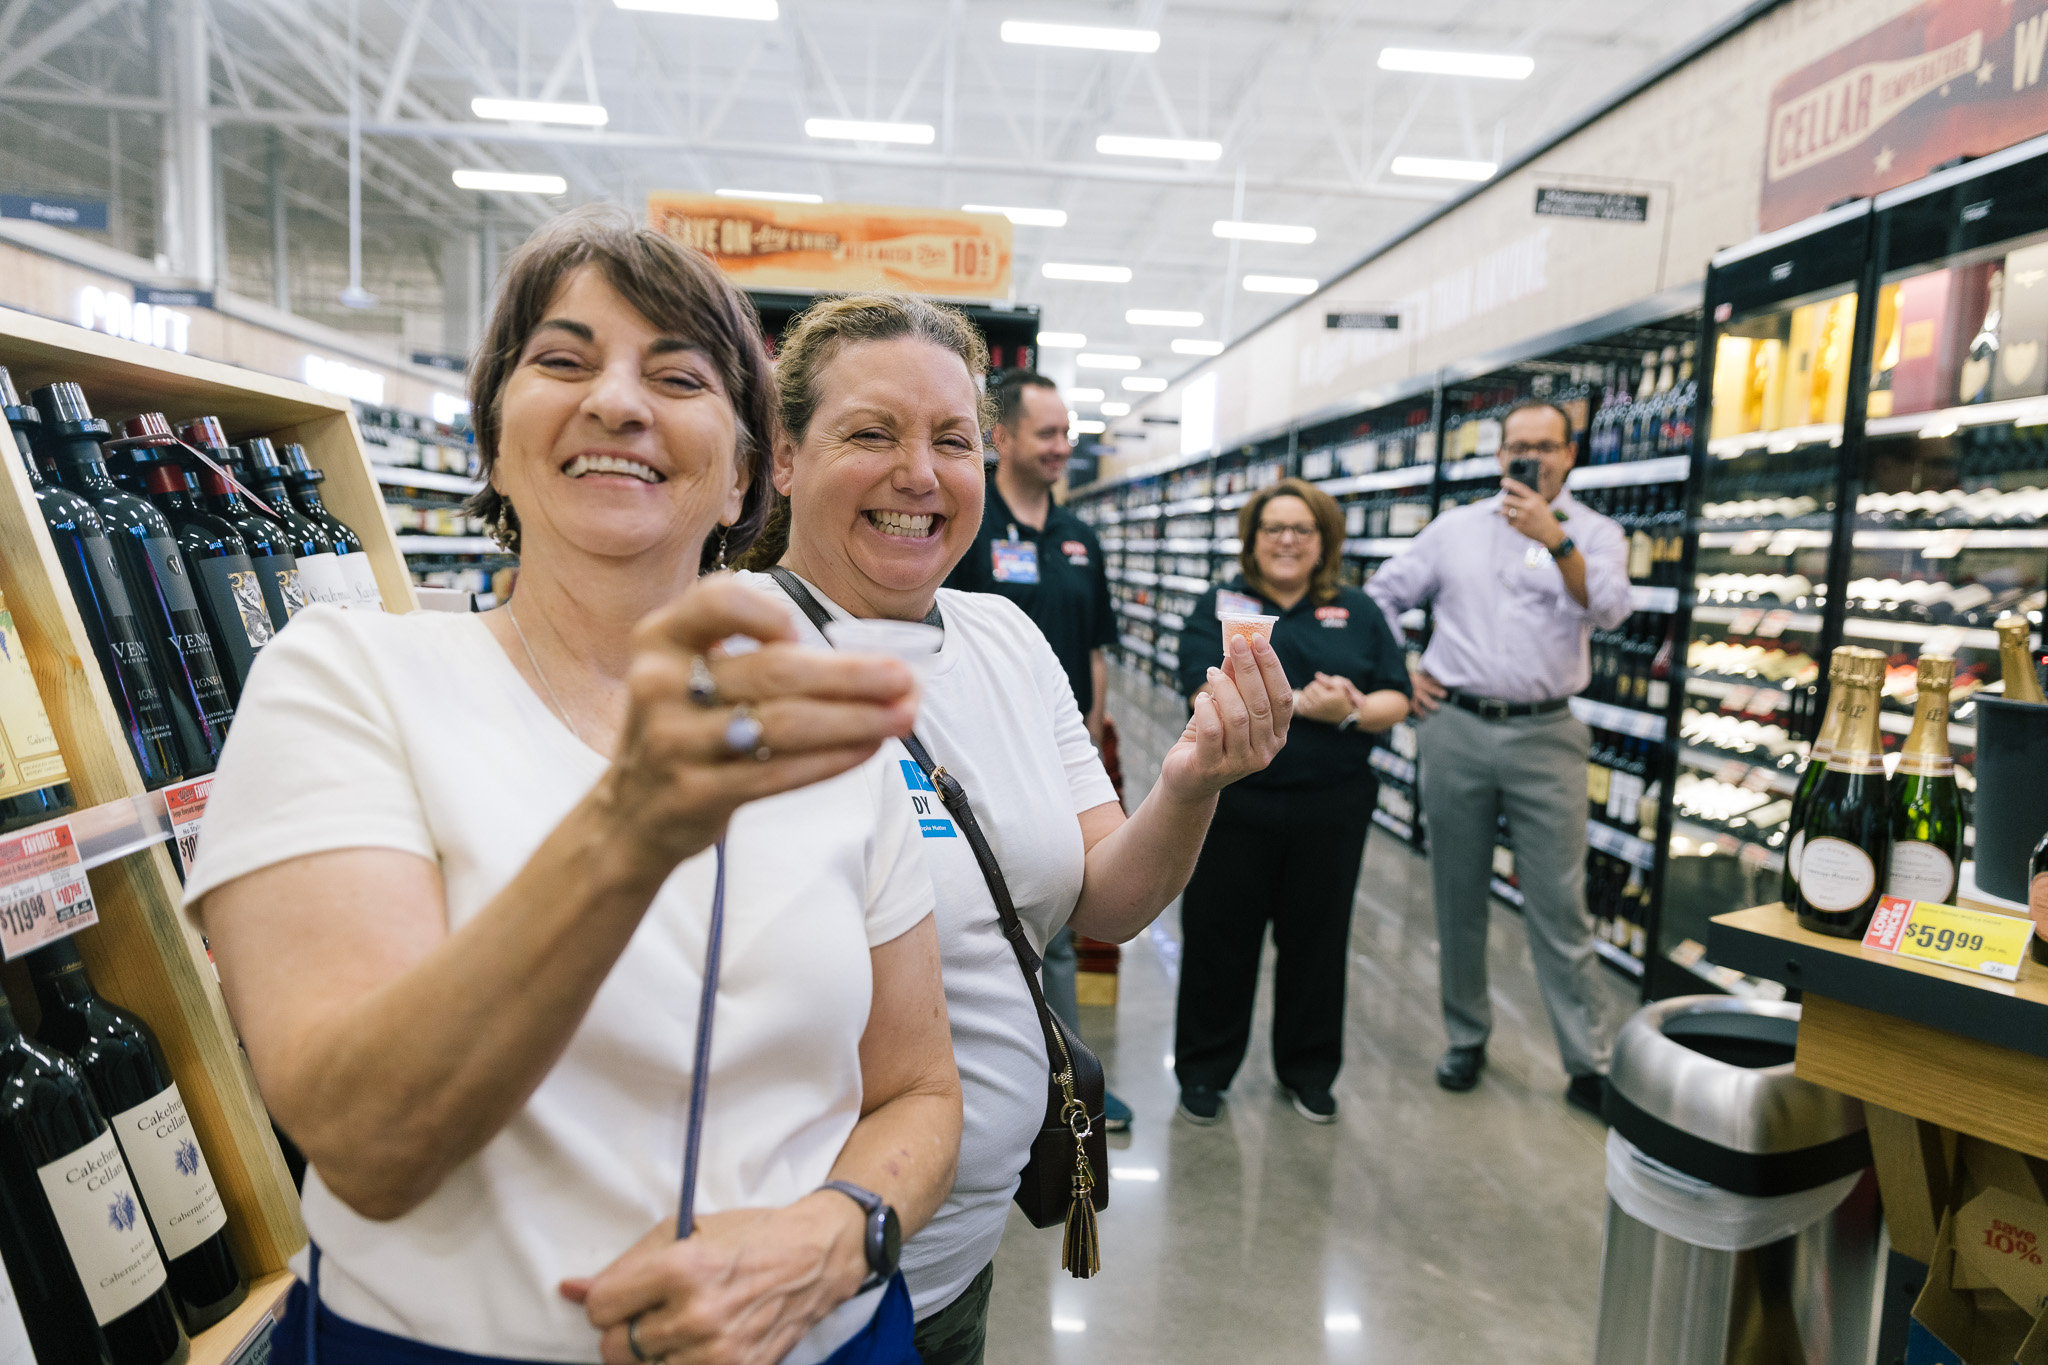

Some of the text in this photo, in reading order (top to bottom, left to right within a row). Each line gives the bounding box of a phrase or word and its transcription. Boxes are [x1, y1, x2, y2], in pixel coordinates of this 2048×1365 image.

[1778, 72, 1874, 168] CELLAR
[1880, 44, 1969, 106] TEMPERATURE
[911, 795, 931, 815] DY
[22, 830, 59, 857] FAVORITE
[1871, 907, 1888, 937] LOW
[1879, 902, 1907, 947] PRICES
[169, 1201, 205, 1227] Cabernet
[1991, 1218, 2037, 1244] save
[1983, 1228, 2043, 1265] 10%
[99, 1261, 142, 1289] Cabernet
